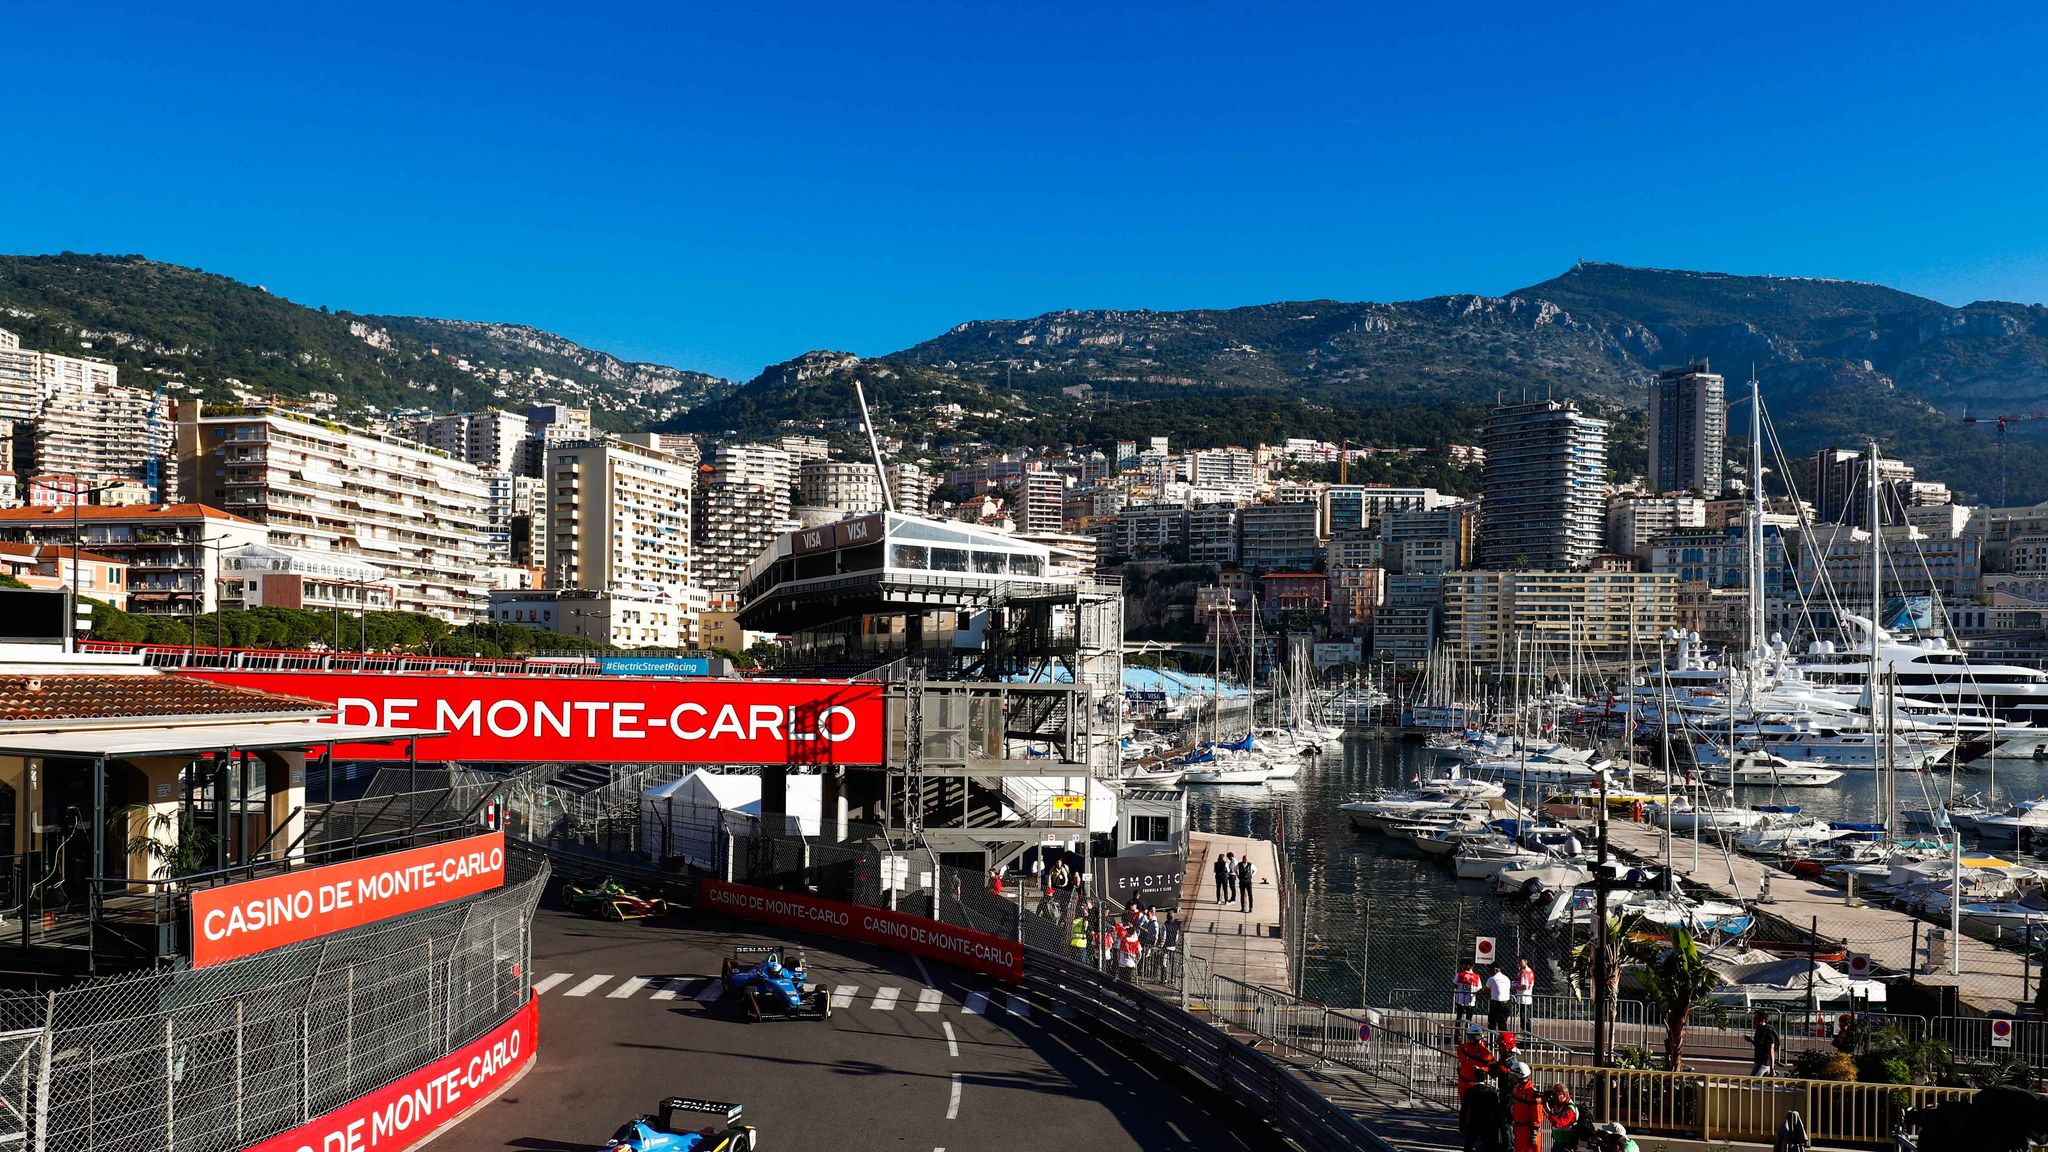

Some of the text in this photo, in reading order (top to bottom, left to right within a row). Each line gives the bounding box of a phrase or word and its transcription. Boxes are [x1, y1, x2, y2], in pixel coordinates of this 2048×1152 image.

[802, 531, 822, 549] VISA
[846, 521, 868, 541] VISA
[606, 662, 697, 673] #ElectricStreetRacing
[436, 699, 857, 742] MONTE-CARLO
[203, 847, 503, 941] CASINO DE MONTE-CARLO
[709, 889, 849, 926] CASINO DE MONTE-CARLO
[863, 916, 1014, 967] CASINO DE MONTE-CARLO
[371, 1029, 520, 1147] MONTE-CARLO
